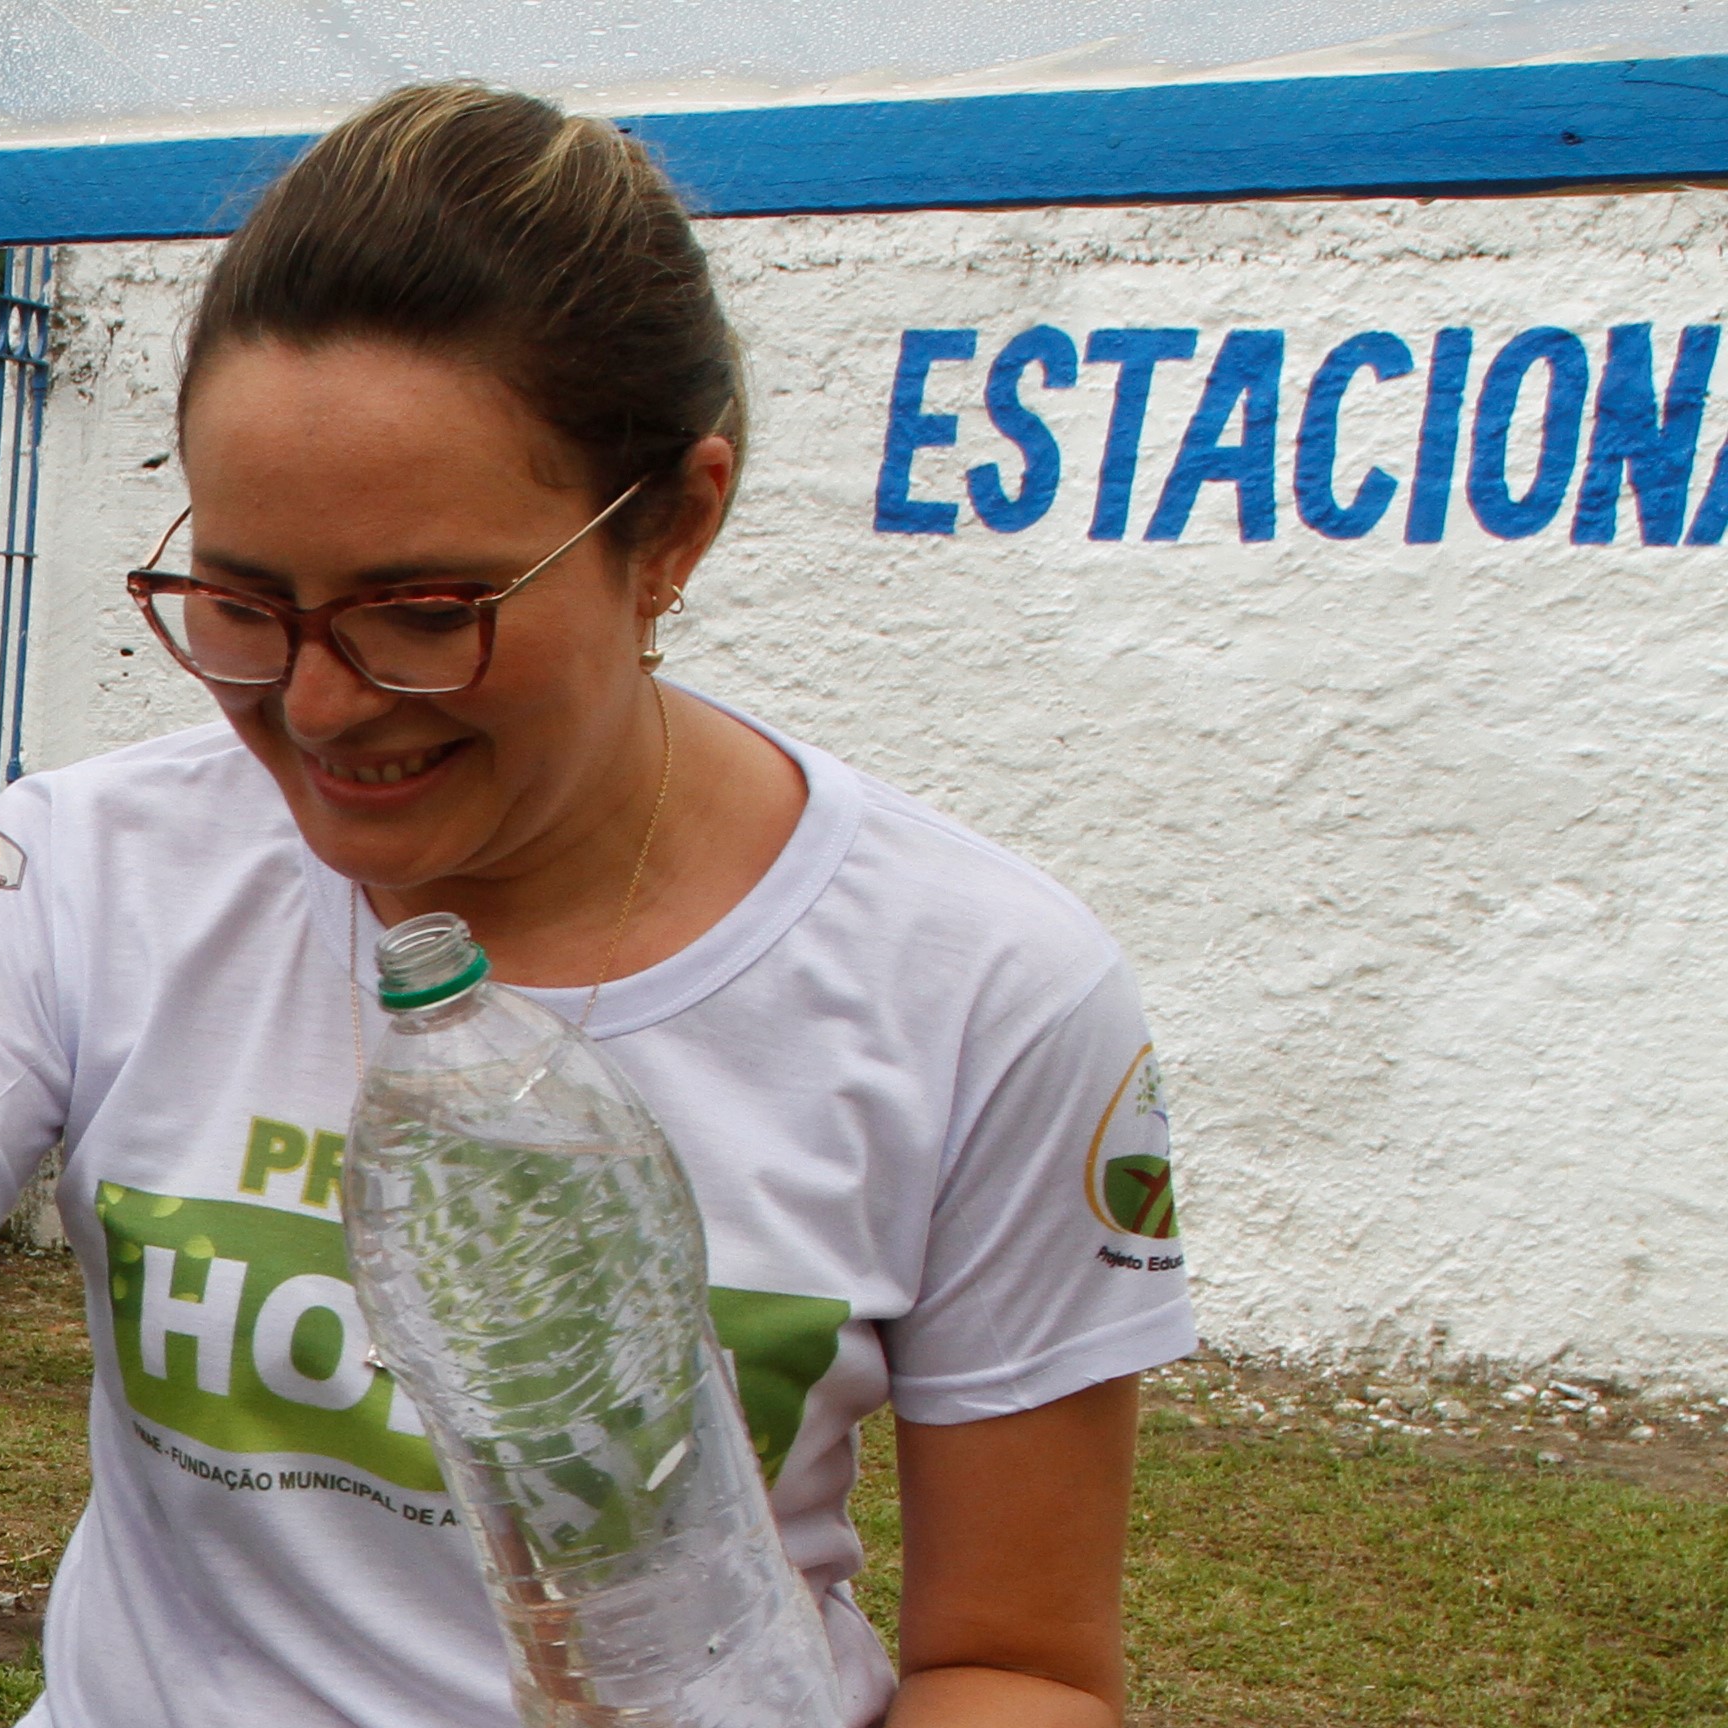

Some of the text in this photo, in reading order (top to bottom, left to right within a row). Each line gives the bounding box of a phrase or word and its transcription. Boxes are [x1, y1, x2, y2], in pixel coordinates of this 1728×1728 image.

[238, 1115, 349, 1209] PR
[140, 1244, 426, 1437] HO
[171, 1446, 272, 1491] FUNDAÇÃO
[279, 1470, 397, 1513] MUNICIPAL
[403, 1503, 434, 1525] DE
